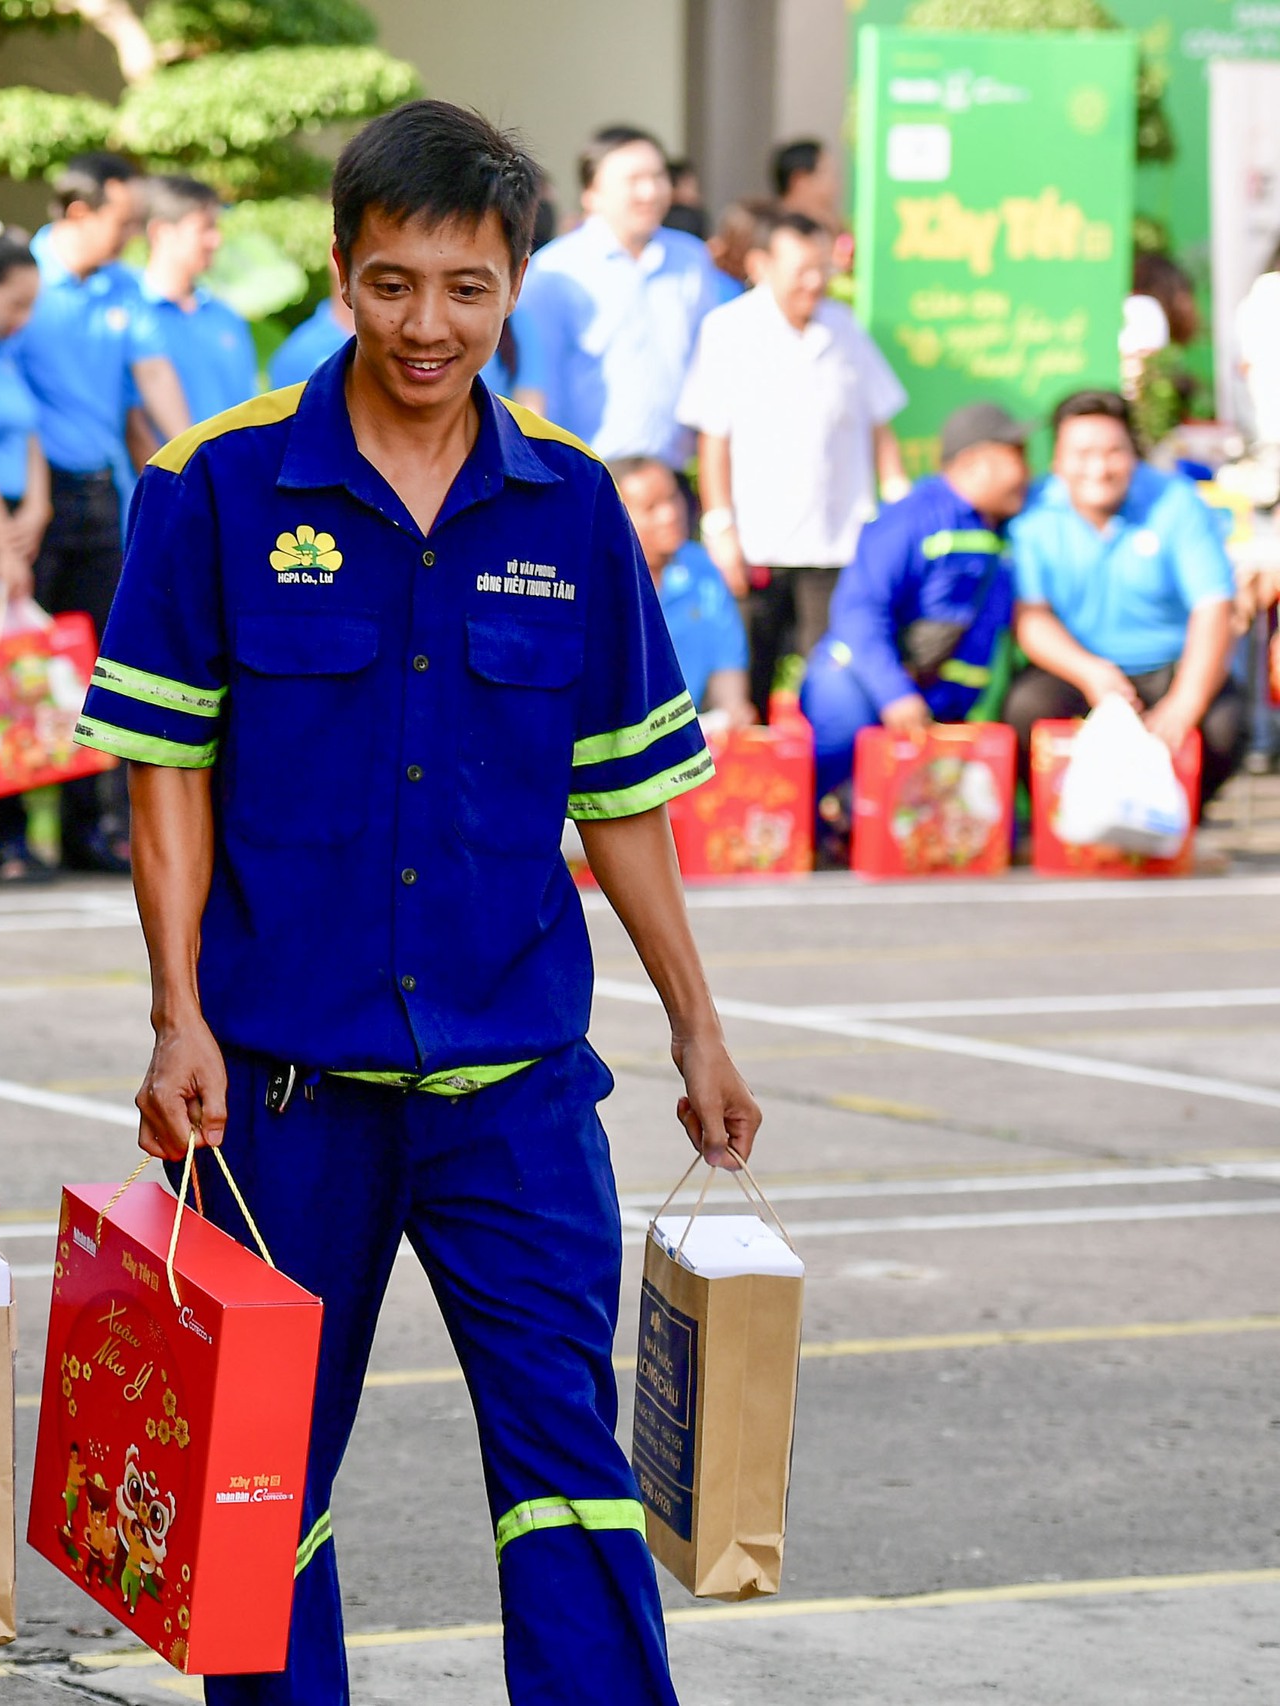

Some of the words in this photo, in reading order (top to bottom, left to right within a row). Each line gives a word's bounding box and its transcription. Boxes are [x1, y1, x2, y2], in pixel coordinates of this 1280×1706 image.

[277, 572, 300, 584] HGPA
[319, 572, 334, 584] Ltd
[476, 572, 502, 593] CÔNG
[503, 575, 526, 595] VIÊN
[526, 579, 551, 598] TRUNG
[552, 580, 575, 601] TÂM
[98, 1299, 141, 1348] Xuân
